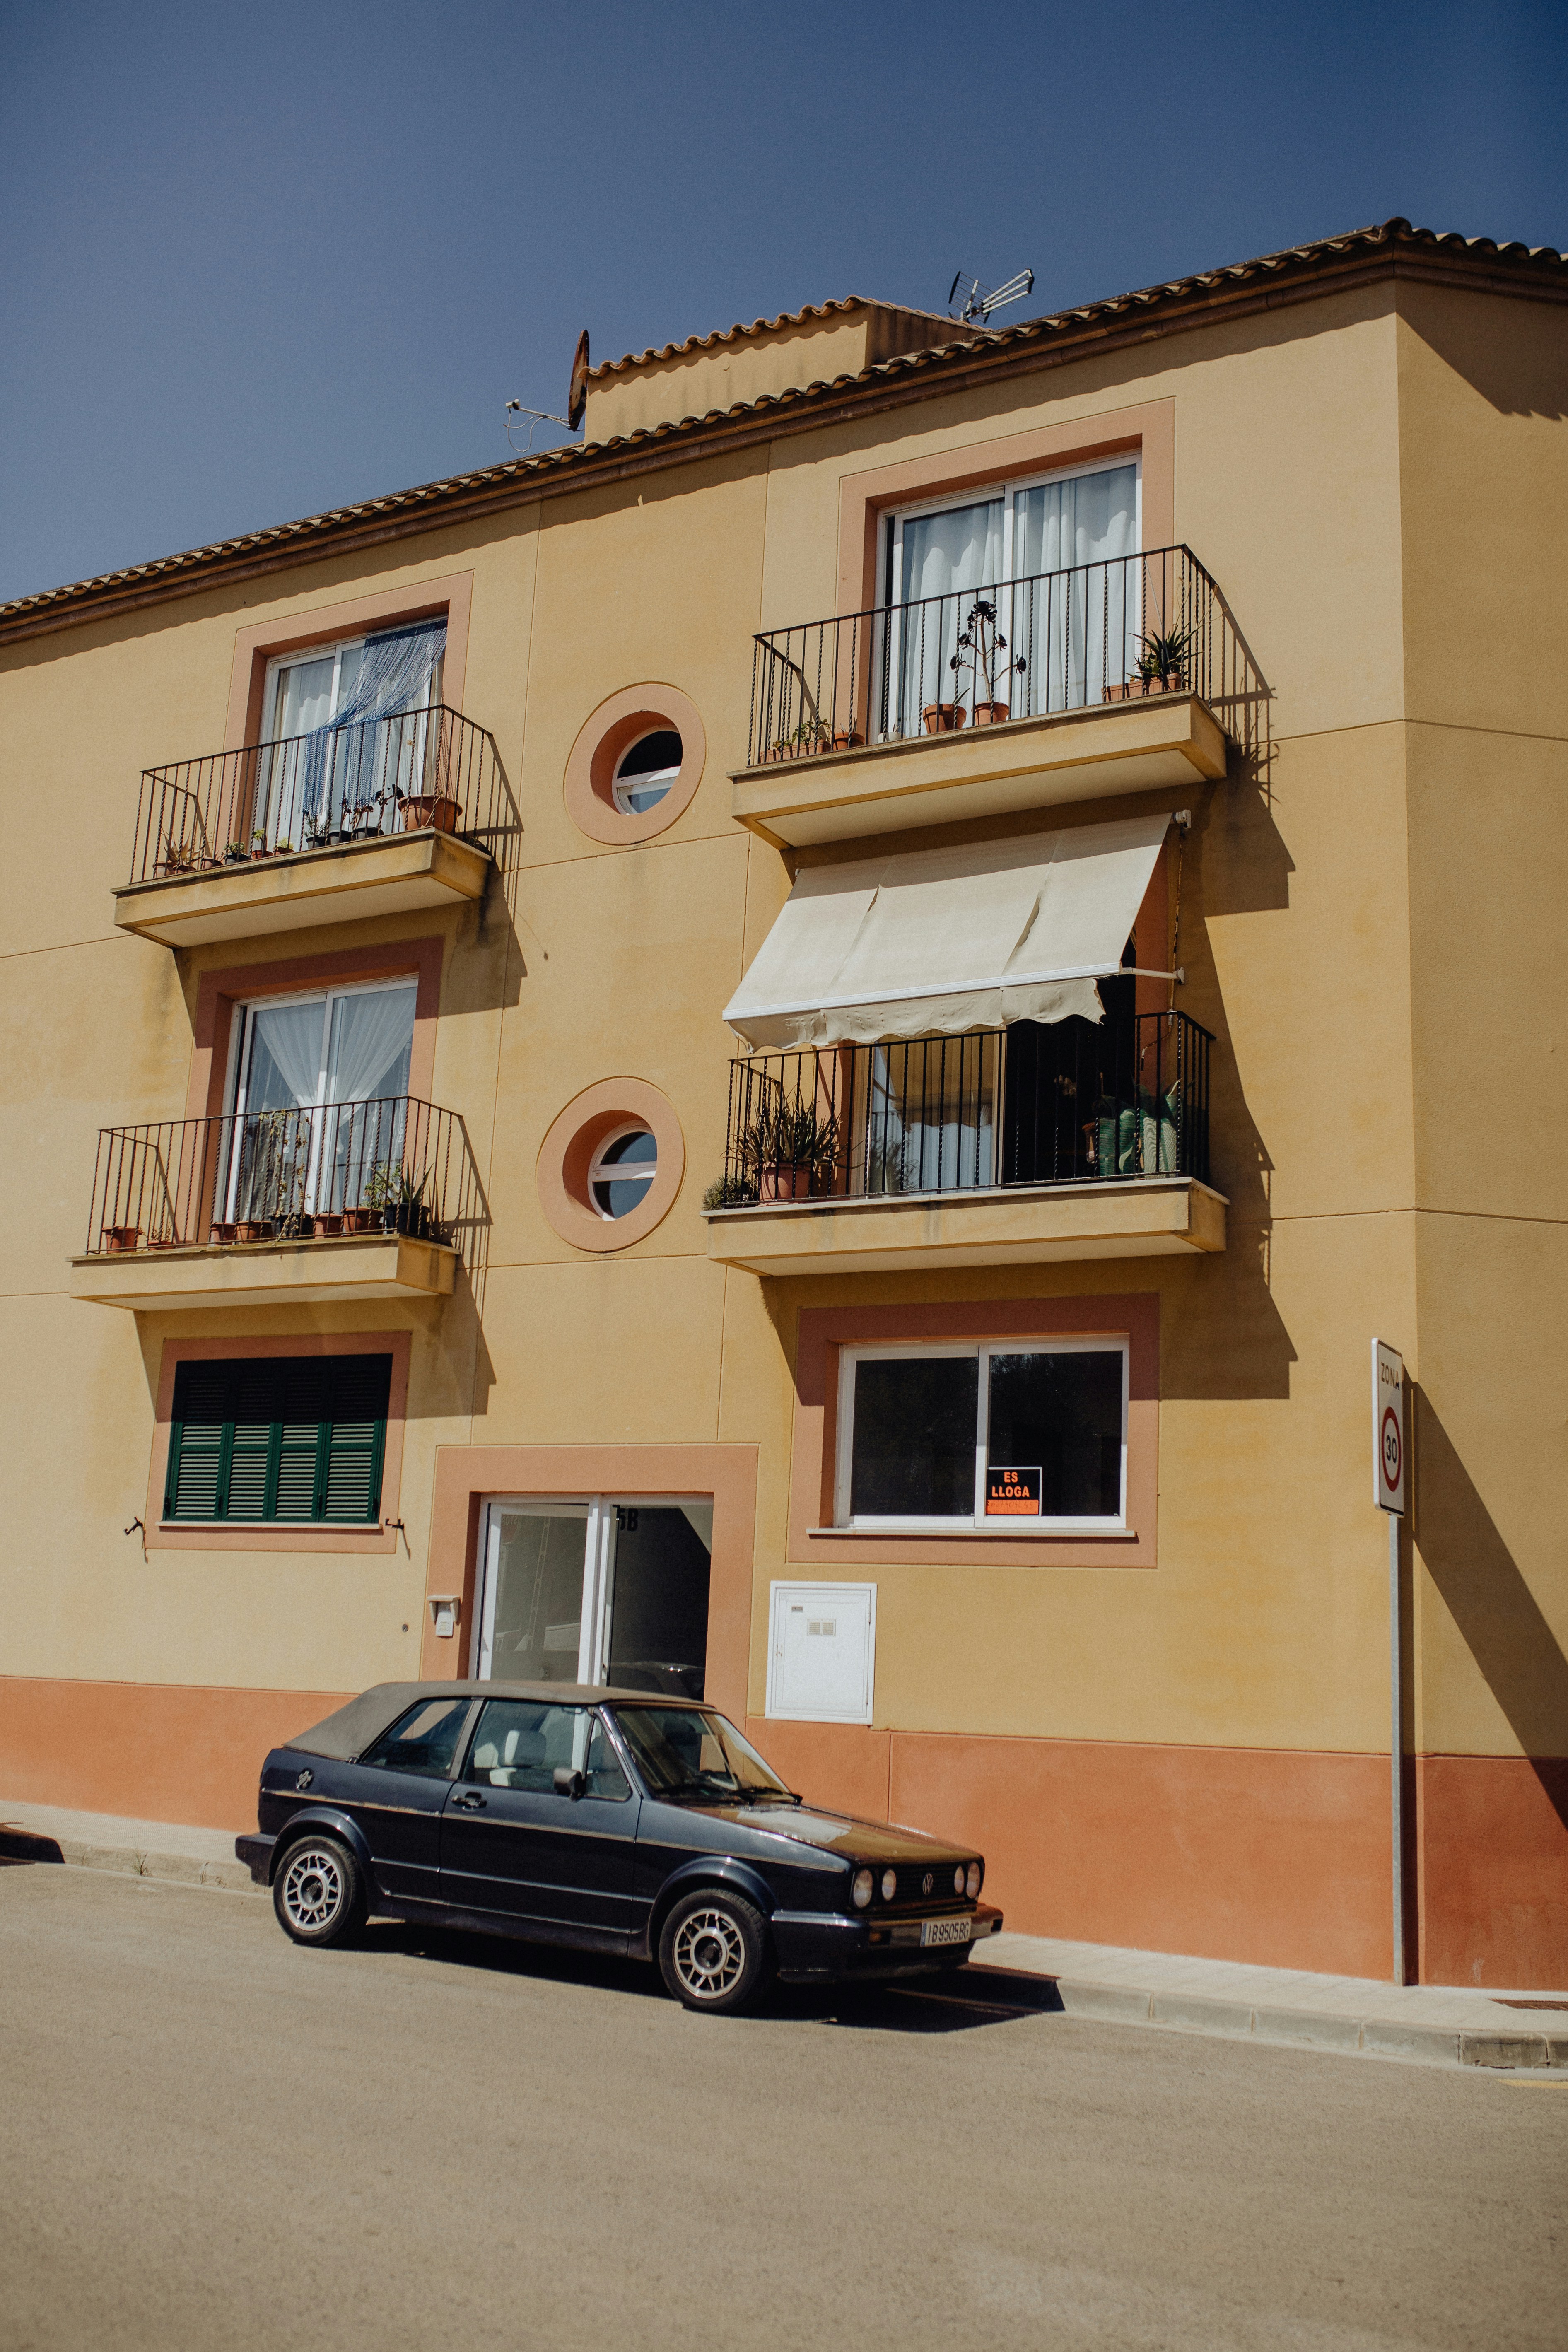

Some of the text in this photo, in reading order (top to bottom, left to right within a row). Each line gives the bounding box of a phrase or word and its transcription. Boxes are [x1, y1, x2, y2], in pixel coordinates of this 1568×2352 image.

[1380, 1362, 1400, 1390] ZONA
[1386, 1435, 1397, 1464] 30
[1004, 1472, 1018, 1483] ES
[992, 1486, 1030, 1497] LLOGA
[922, 1873, 933, 1896] VW
